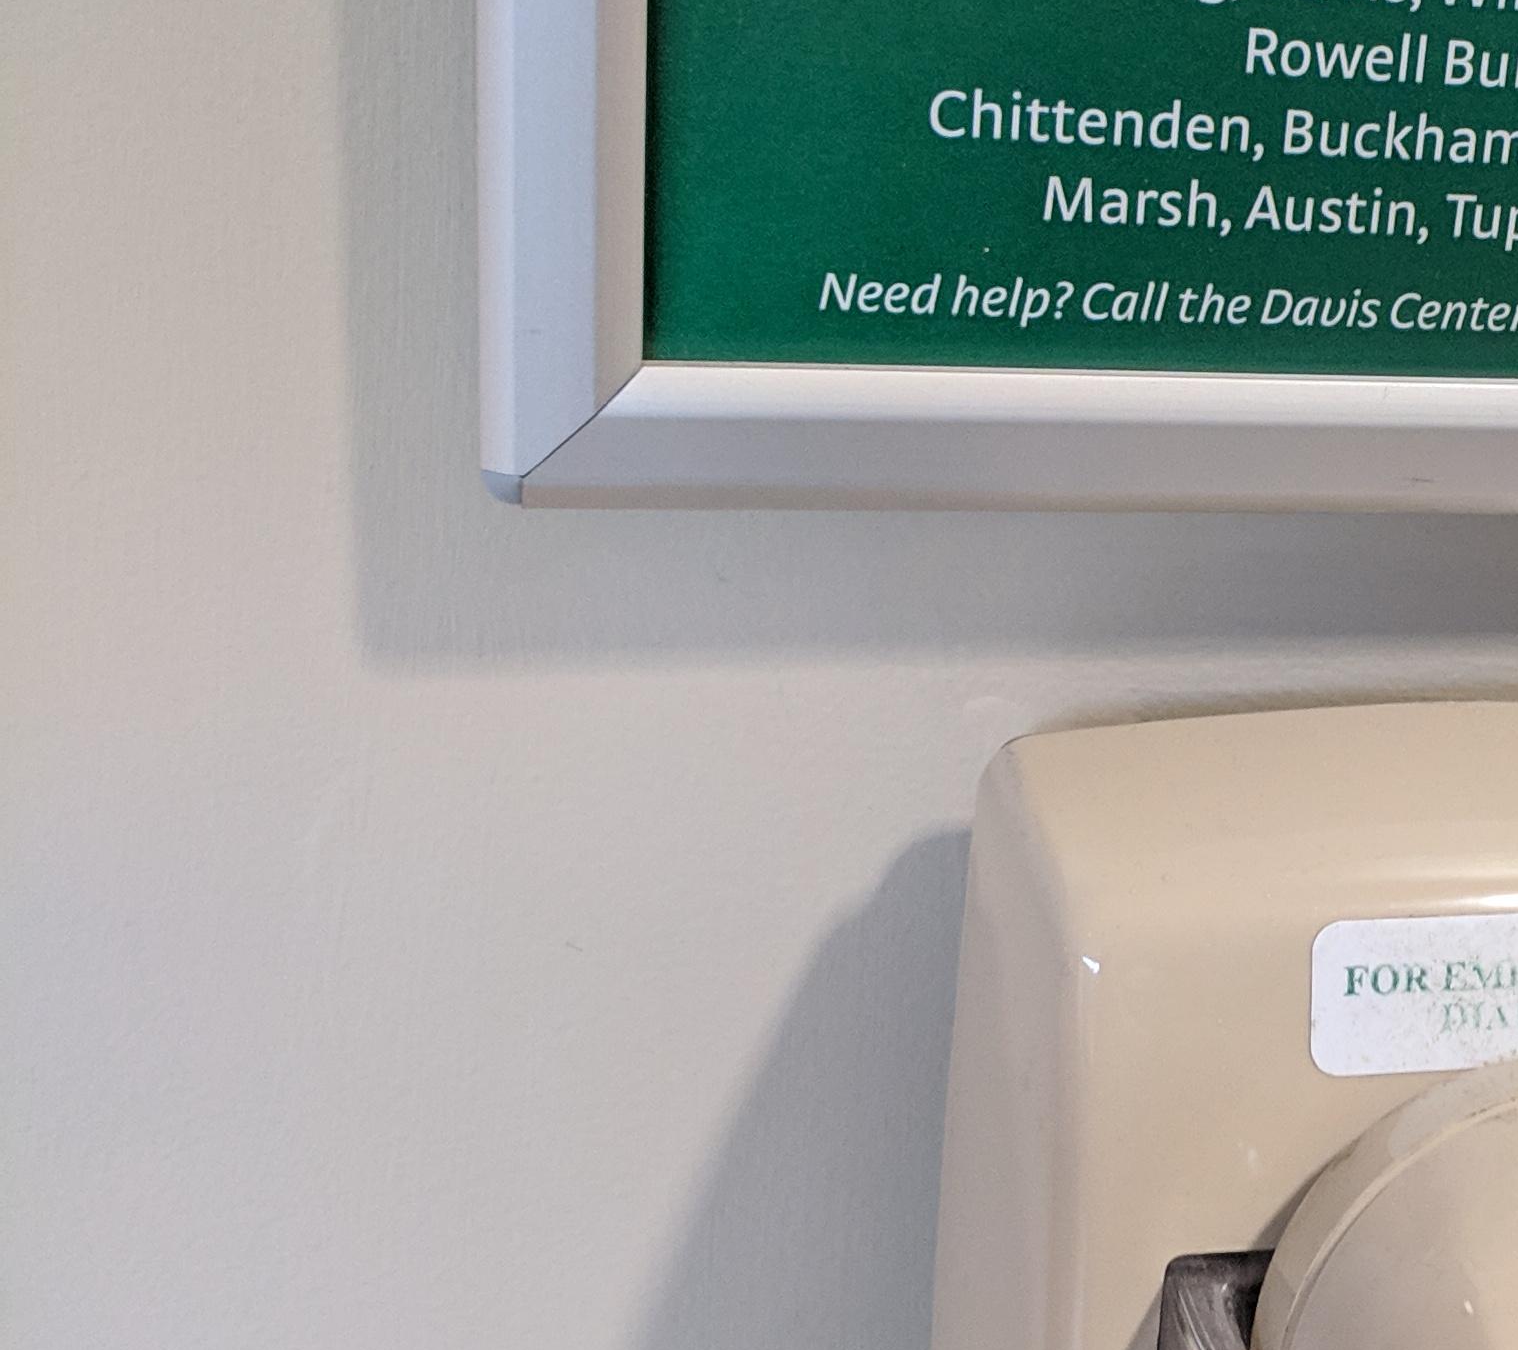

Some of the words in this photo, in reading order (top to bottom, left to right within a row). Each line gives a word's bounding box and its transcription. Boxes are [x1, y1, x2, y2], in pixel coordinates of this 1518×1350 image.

[1245, 27, 1428, 83] Rowell
[929, 88, 1264, 161] Chittenden,
[1043, 175, 1232, 237] Marsh,
[1244, 185, 1429, 244] Austin,
[819, 272, 942, 314] Need
[951, 274, 1075, 328] help?
[1082, 281, 1169, 322] Call
[1179, 283, 1252, 325] the
[1260, 288, 1381, 328] Davis
[1343, 964, 1430, 996] FOR
